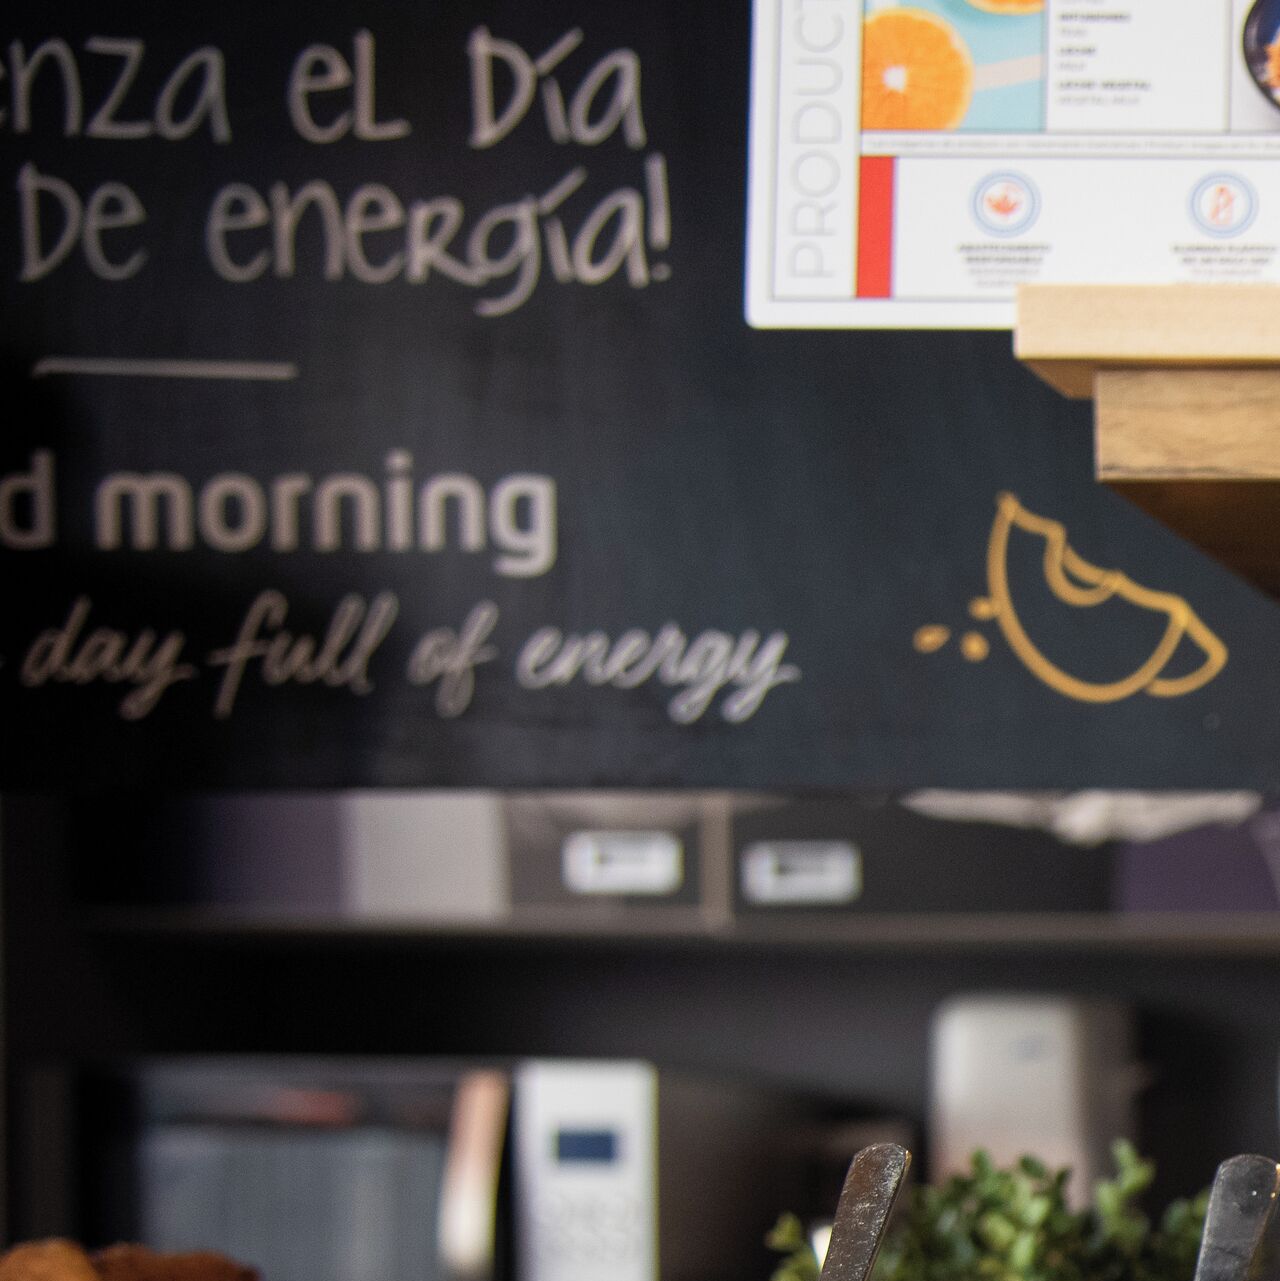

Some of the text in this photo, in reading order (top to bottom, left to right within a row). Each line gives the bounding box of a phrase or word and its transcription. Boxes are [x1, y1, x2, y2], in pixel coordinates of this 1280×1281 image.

[0, 36, 231, 143] nza
[788, 0, 846, 280] PRODUC
[95, 449, 557, 577] morning
[20, 588, 800, 723] day full of energy
